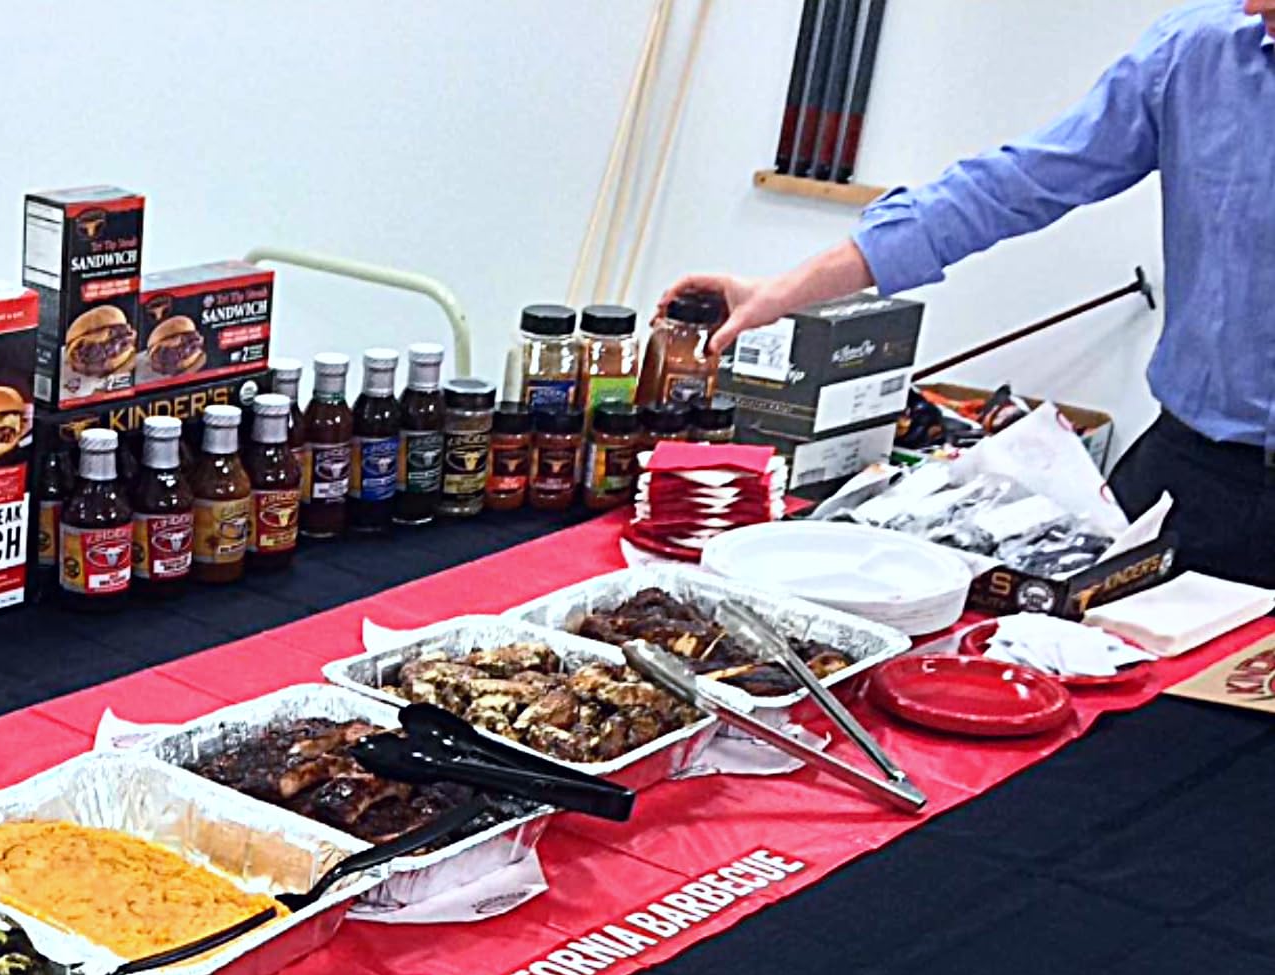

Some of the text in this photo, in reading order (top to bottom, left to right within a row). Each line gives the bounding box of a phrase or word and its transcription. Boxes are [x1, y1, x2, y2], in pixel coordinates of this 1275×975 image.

[71, 249, 138, 271] SANDWICH
[201, 300, 268, 324] SANDWICH
[109, 386, 229, 430] KINDER'S
[632, 850, 805, 947] BARBECUE
